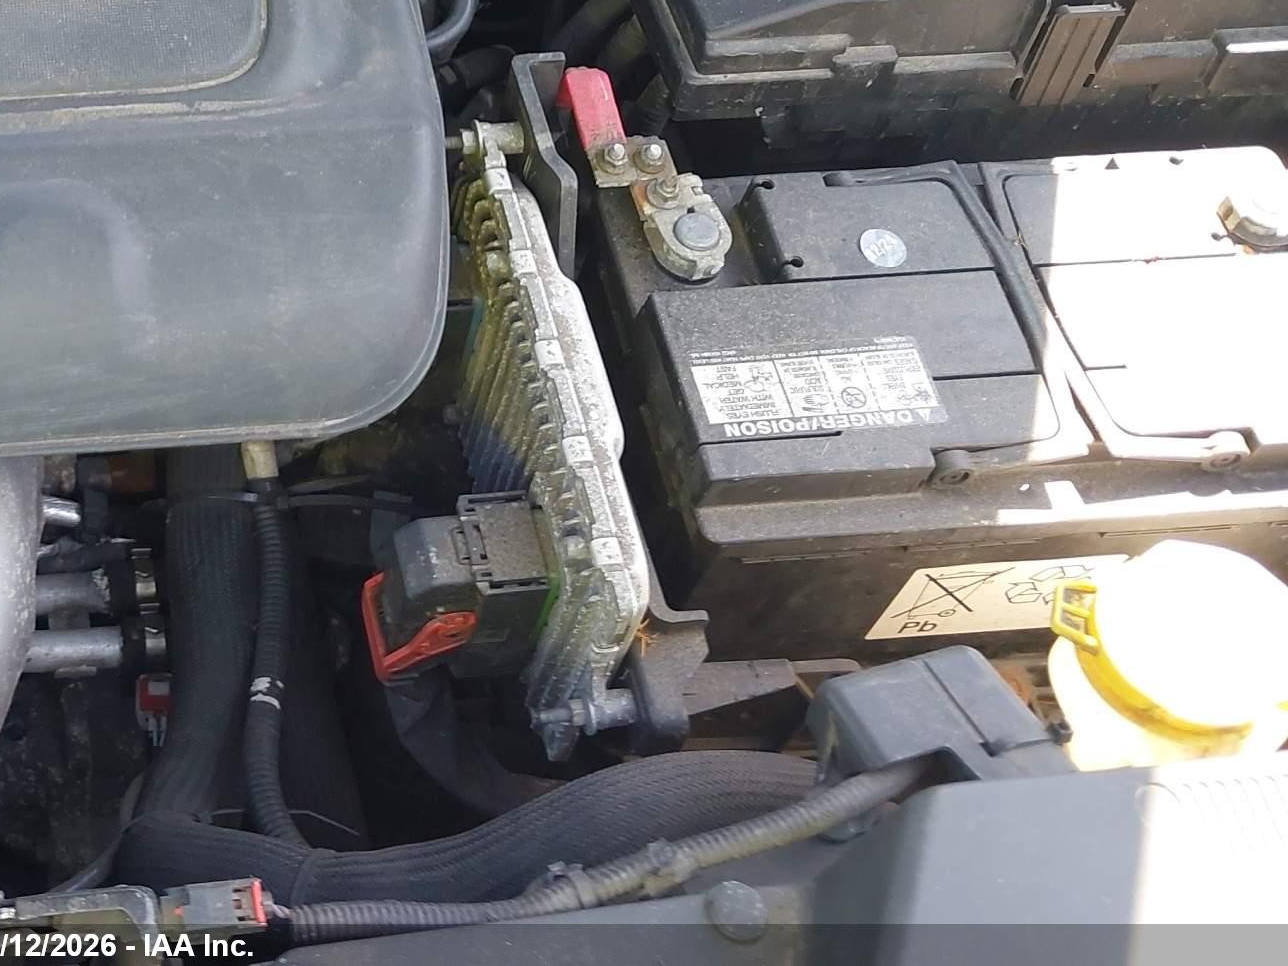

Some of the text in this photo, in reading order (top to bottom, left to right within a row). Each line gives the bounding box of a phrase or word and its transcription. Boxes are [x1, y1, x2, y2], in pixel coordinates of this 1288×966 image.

[715, 365, 737, 373] FAST
[702, 380, 743, 389] MEDICAL
[718, 402, 777, 412] IMMEDIATELY
[750, 409, 780, 417] FLUSH
[723, 409, 914, 437] DANGER/POISON
[898, 621, 937, 634] Pb
